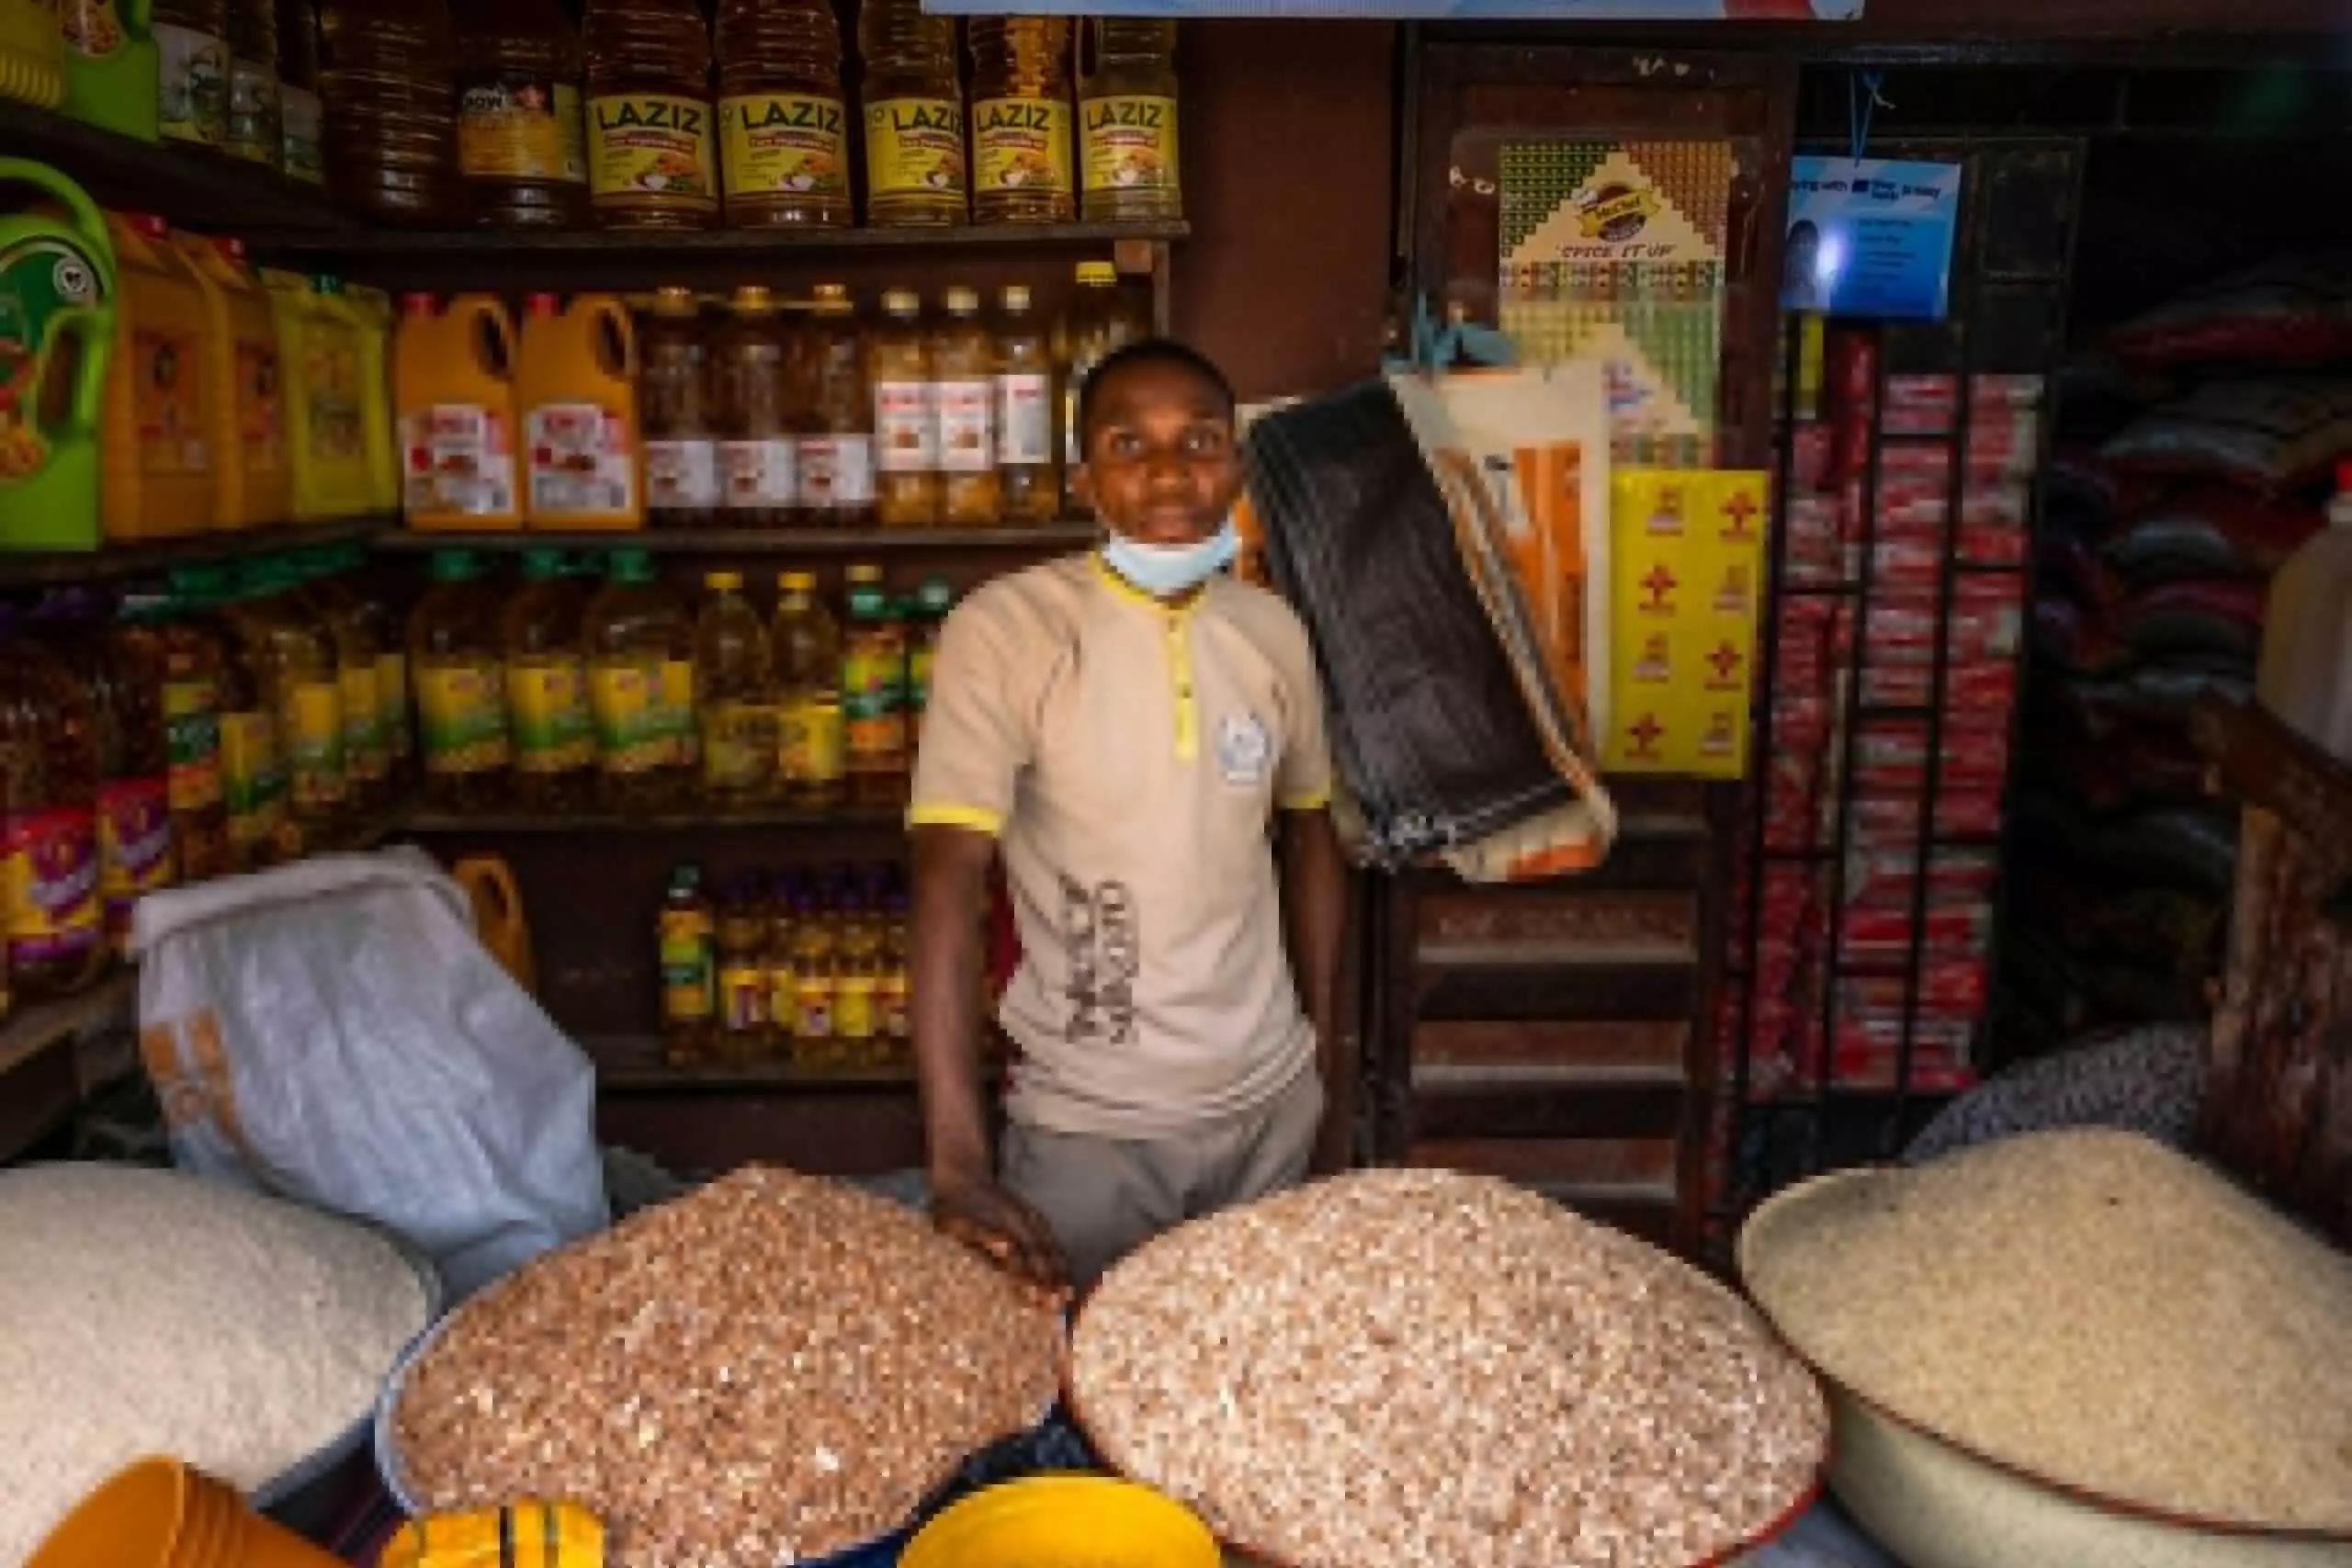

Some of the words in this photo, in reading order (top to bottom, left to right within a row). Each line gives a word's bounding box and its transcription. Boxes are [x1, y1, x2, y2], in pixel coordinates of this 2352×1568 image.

[597, 102, 701, 135] LAZIZ
[741, 101, 841, 134] LAZIZ
[977, 103, 1051, 131] LAZIZ
[1087, 102, 1163, 131] LAZIZ
